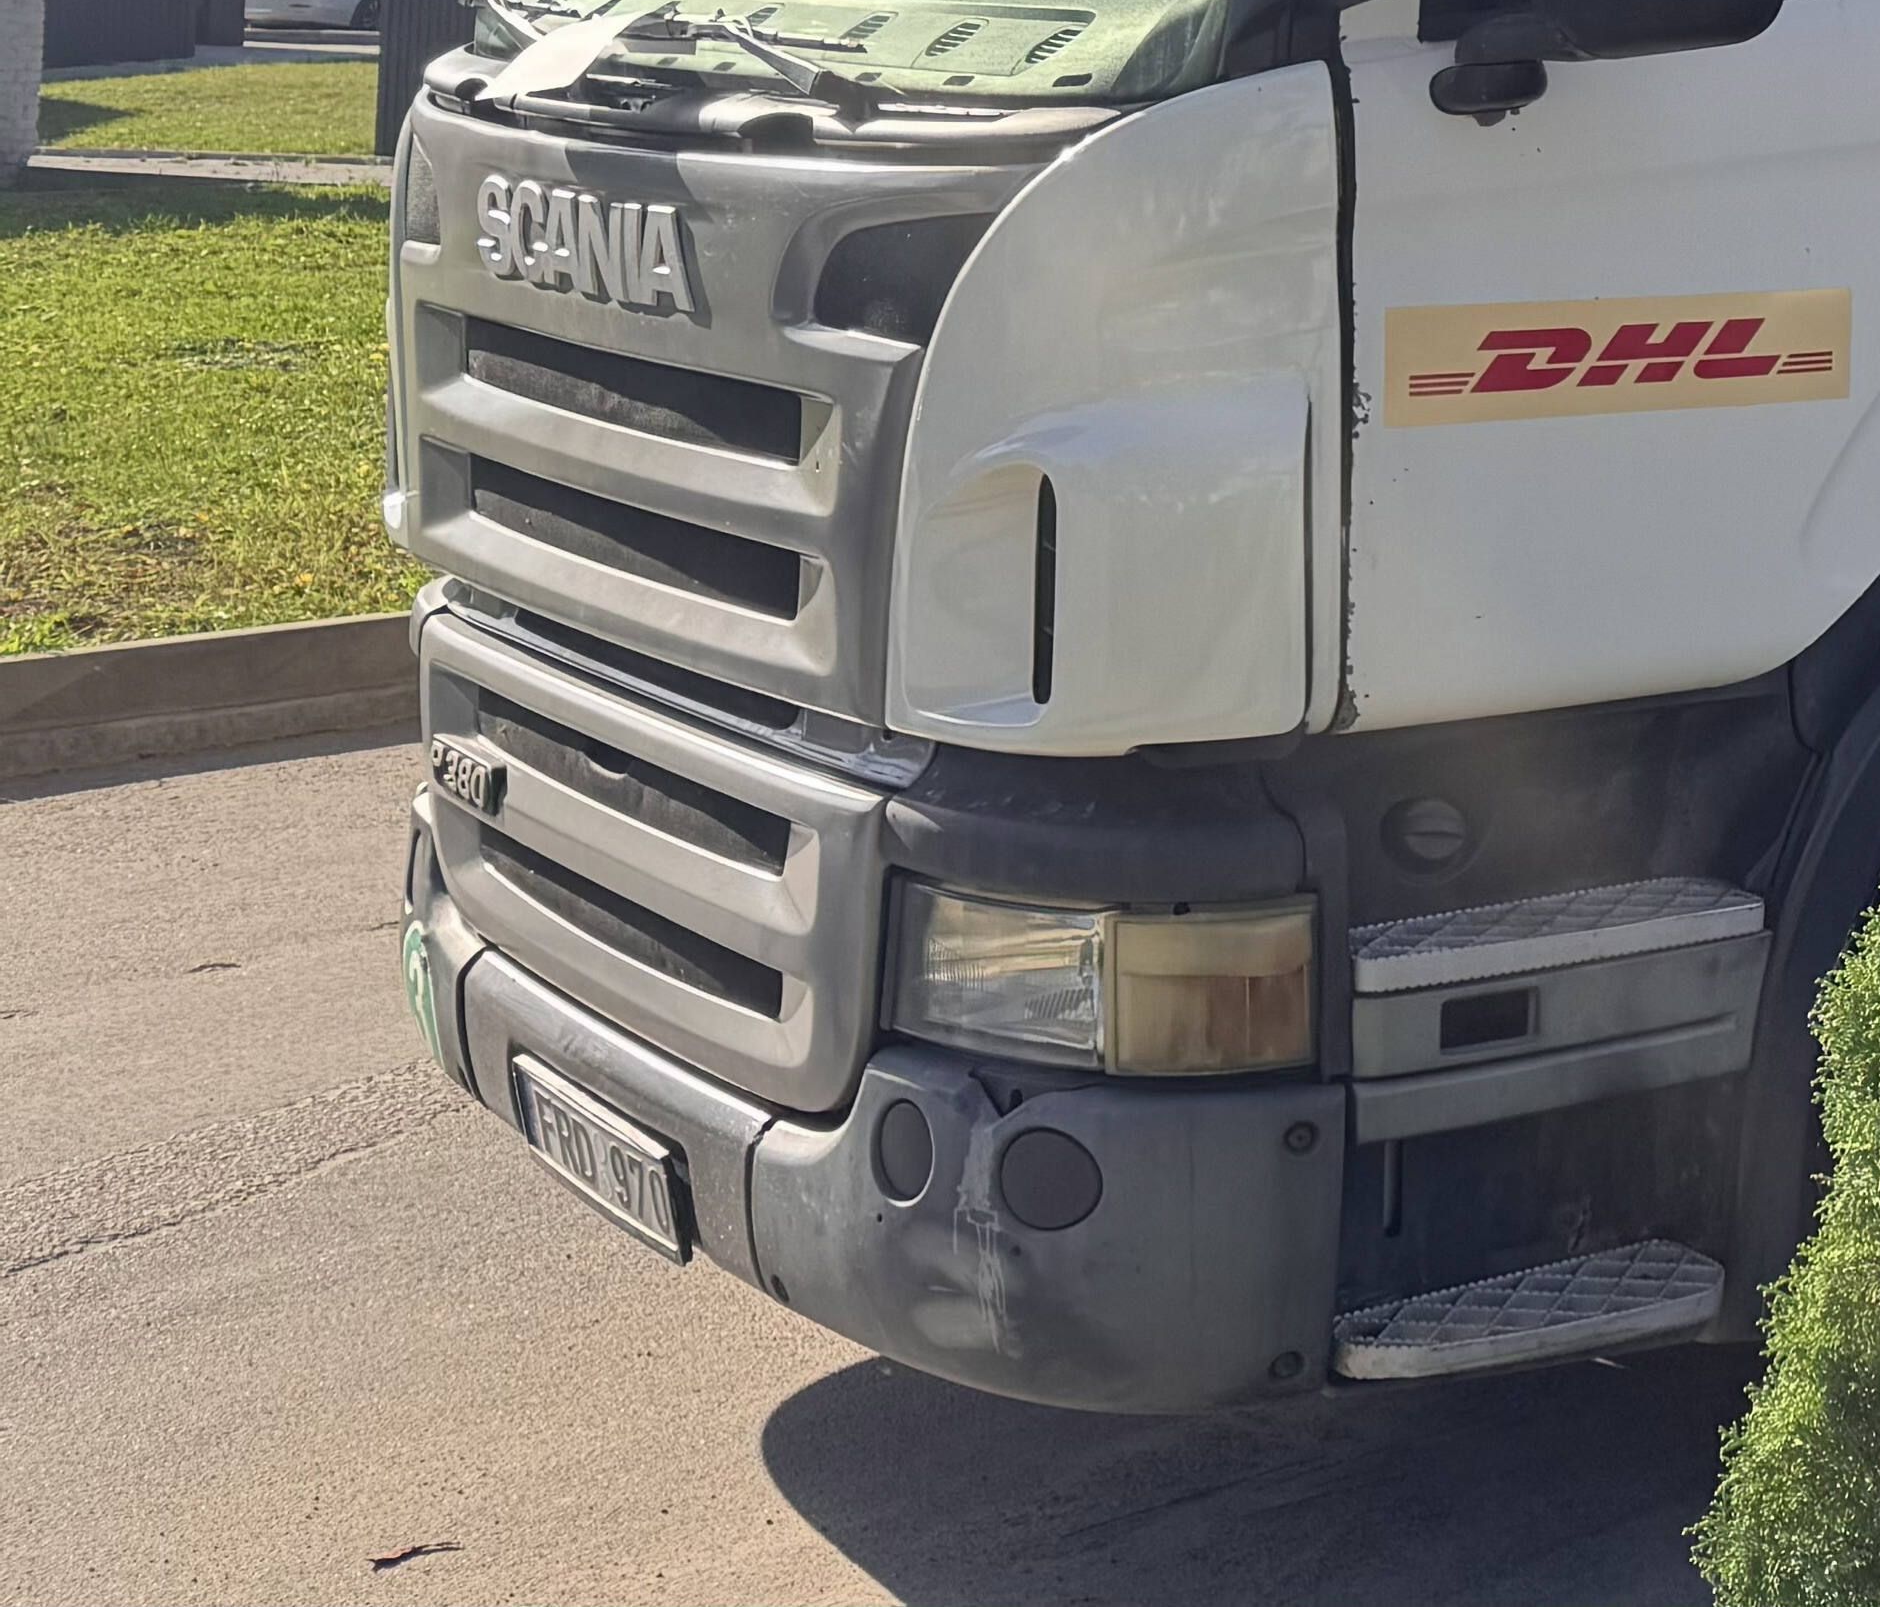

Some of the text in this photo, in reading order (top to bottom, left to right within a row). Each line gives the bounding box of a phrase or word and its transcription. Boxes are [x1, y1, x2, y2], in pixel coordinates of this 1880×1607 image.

[477, 174, 696, 313] SCANIA
[1470, 317, 1781, 394] DHL
[608, 1144, 670, 1236] 970
